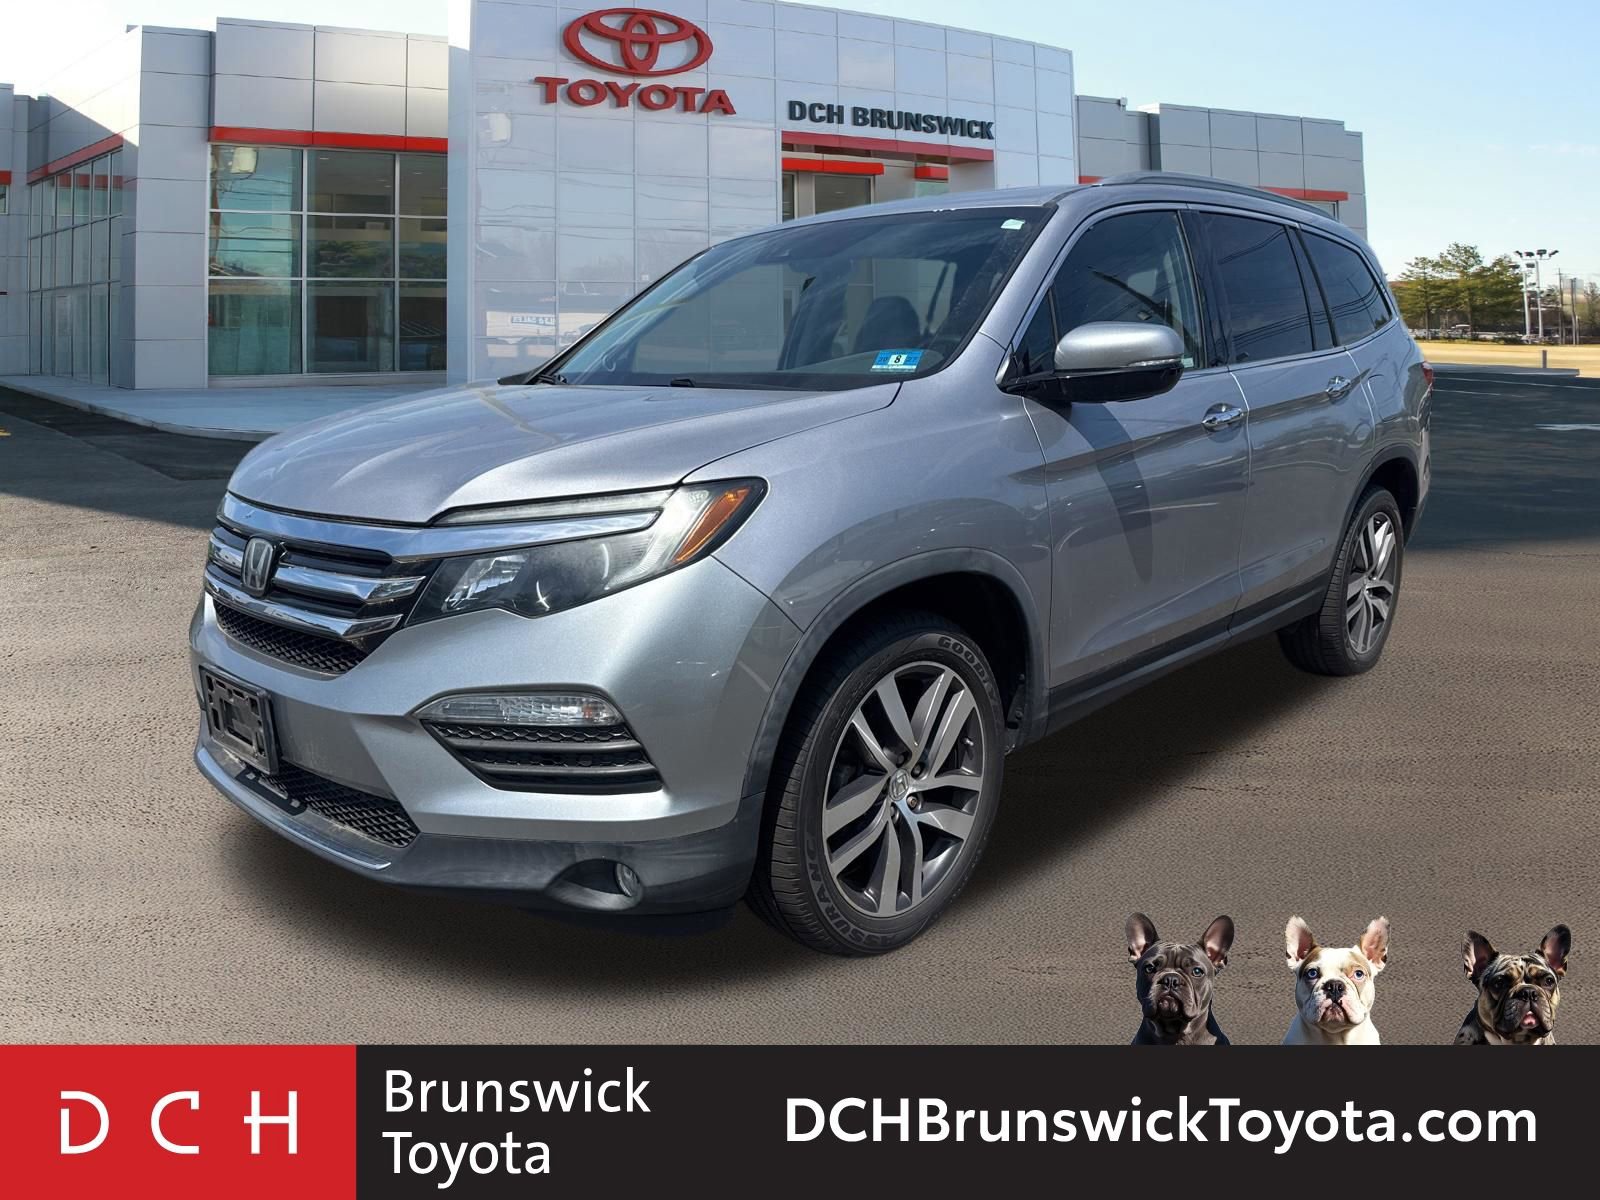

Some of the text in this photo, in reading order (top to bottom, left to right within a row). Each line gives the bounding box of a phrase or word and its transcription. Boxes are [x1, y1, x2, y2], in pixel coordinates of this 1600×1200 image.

[534, 76, 737, 115] TOYOTA
[788, 99, 995, 140] DCH BRUNSWICK
[894, 354, 902, 363] 8
